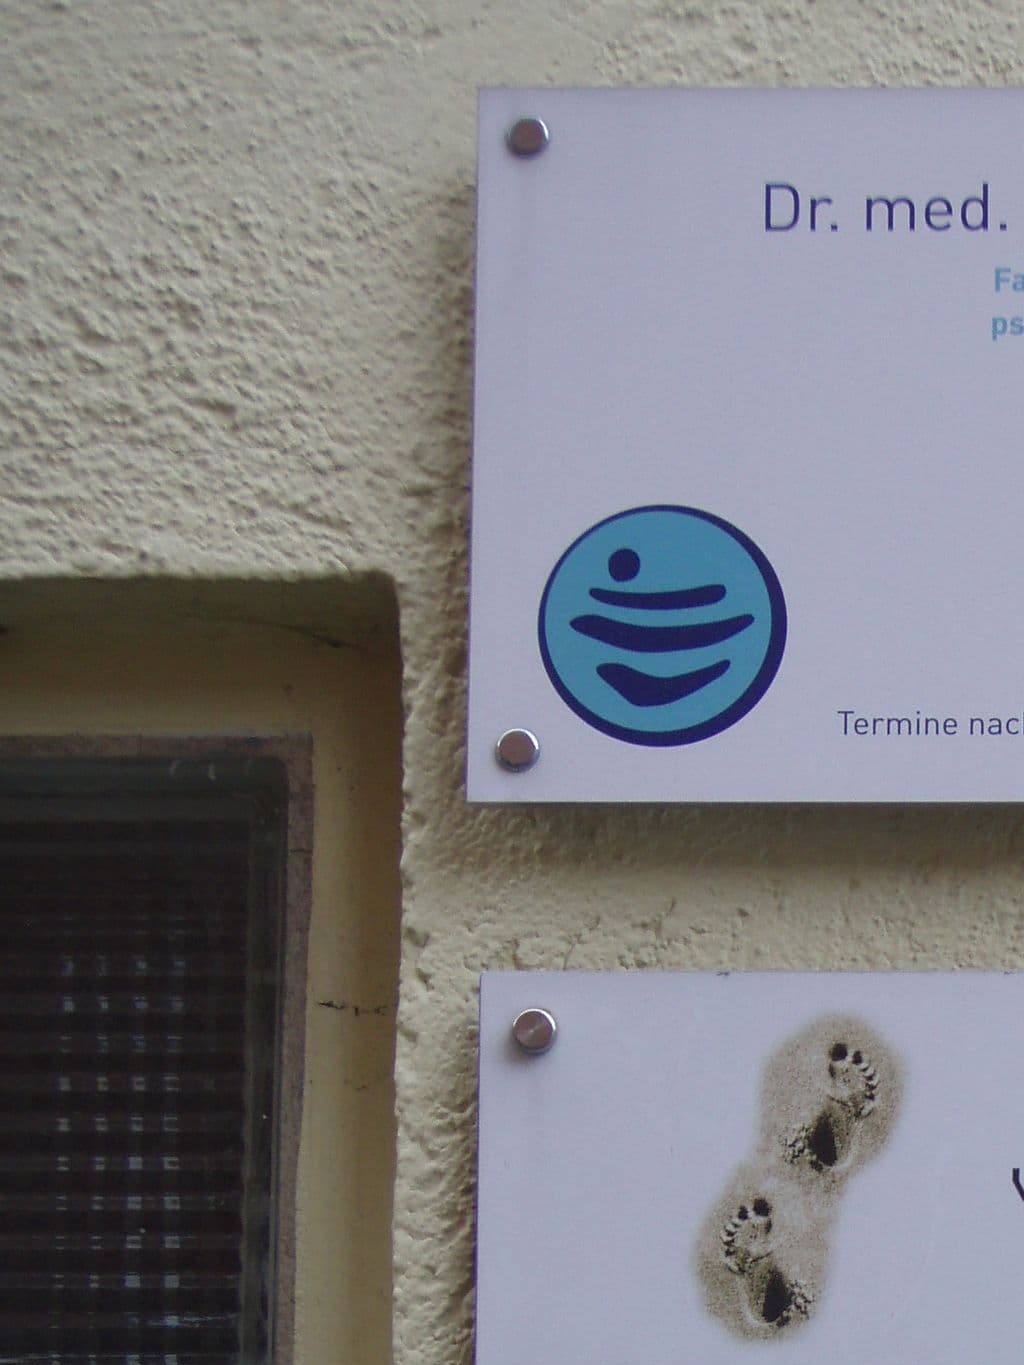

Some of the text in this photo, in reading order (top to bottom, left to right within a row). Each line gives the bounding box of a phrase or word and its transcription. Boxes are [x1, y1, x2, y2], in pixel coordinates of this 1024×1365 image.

[765, 184, 837, 231] Dr.
[867, 184, 1006, 230] med.
[838, 711, 957, 735] Termine
